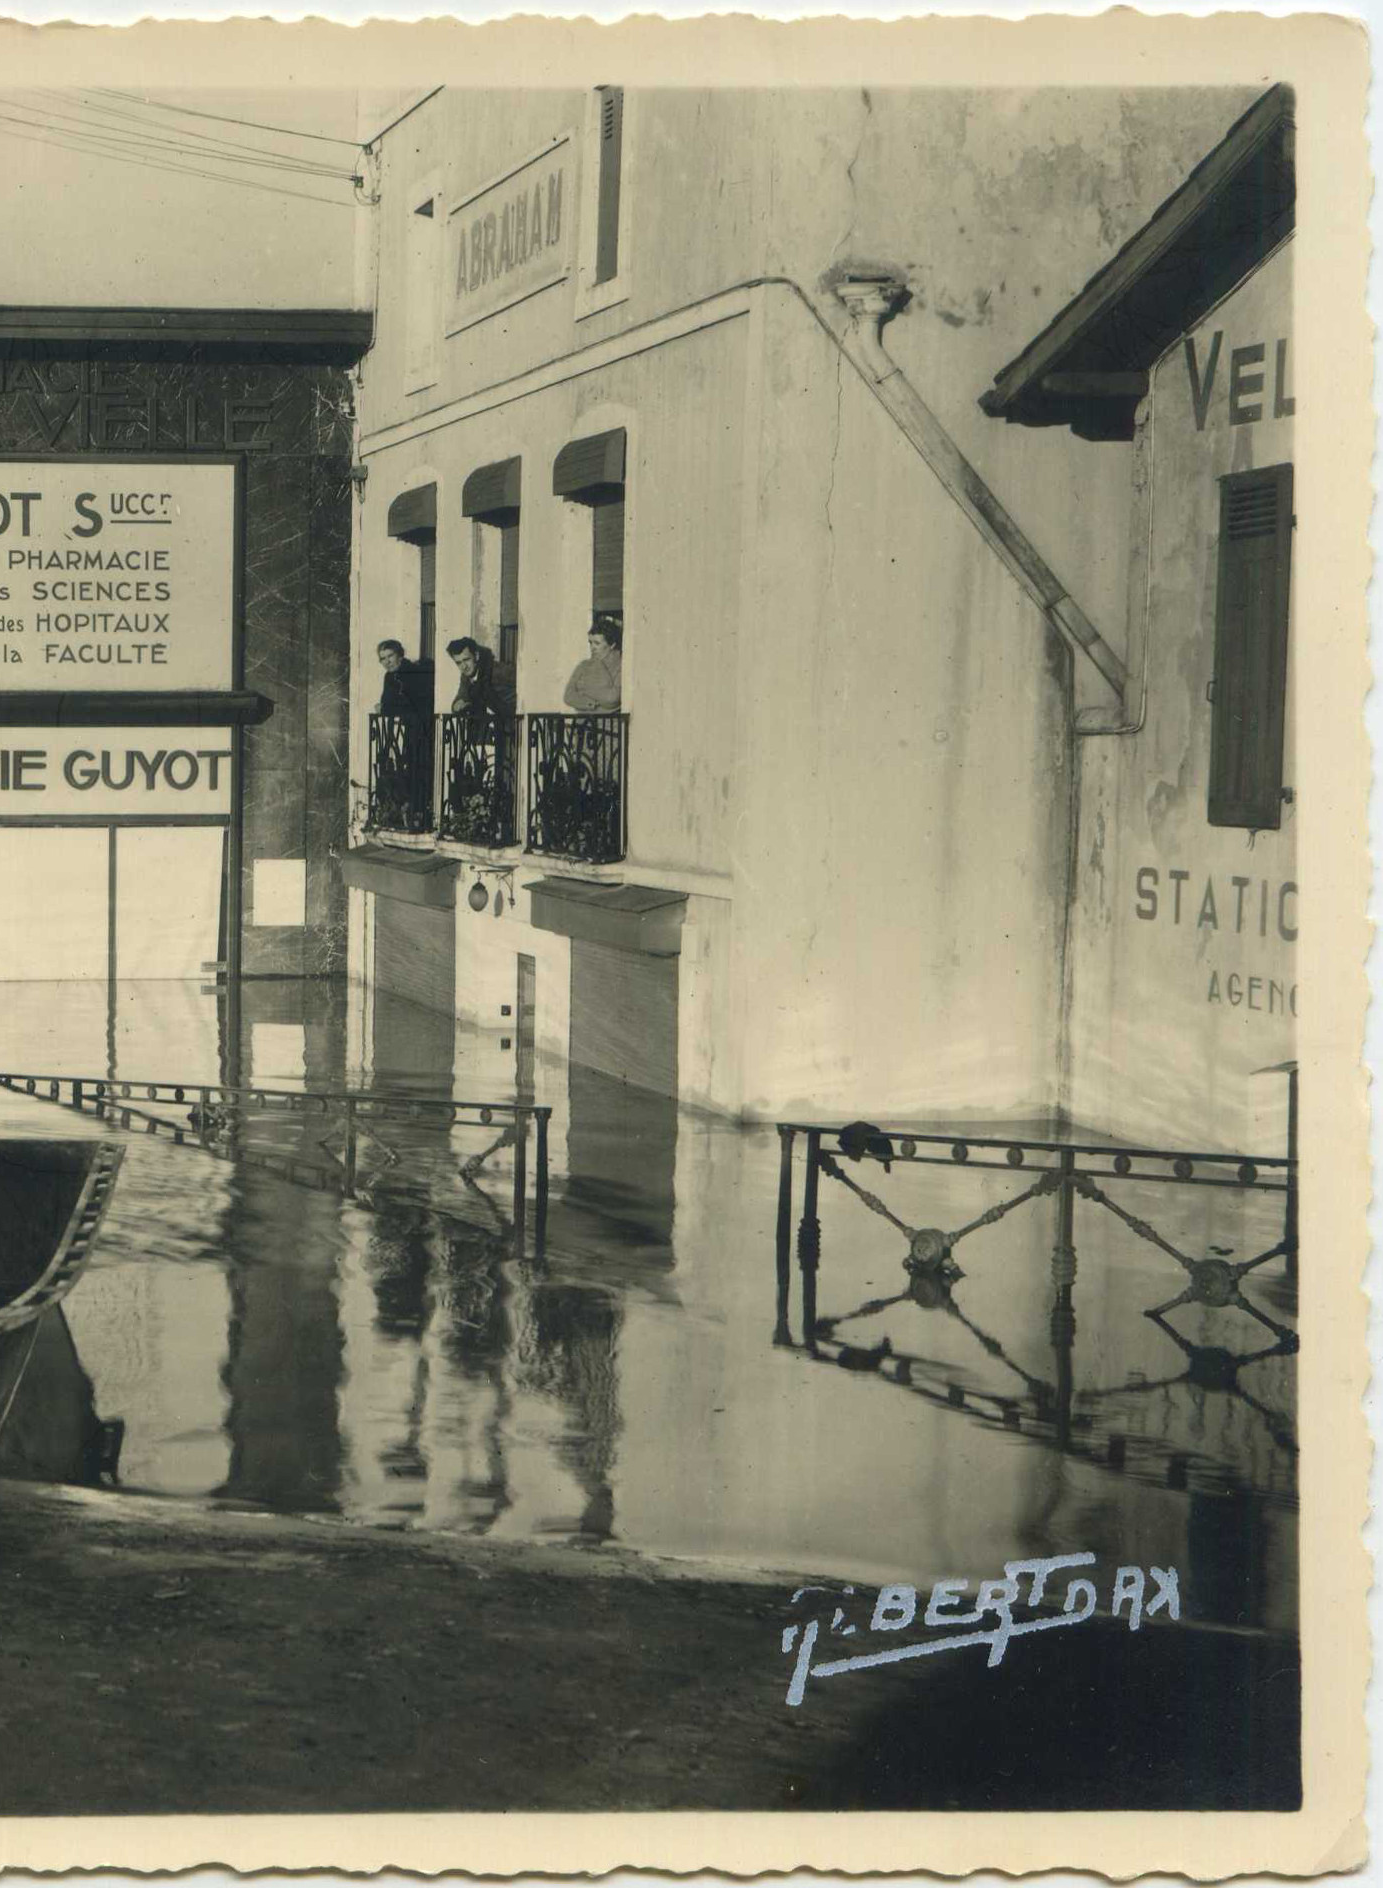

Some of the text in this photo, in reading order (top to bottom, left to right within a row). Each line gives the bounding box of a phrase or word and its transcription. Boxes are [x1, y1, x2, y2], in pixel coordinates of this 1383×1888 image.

[8, 549, 171, 572] PHARMACIE
[32, 581, 171, 602] SCIENCES
[36, 612, 170, 634] HOPITAUX
[3, 643, 23, 664] la
[63, 748, 232, 792] GUYOT
